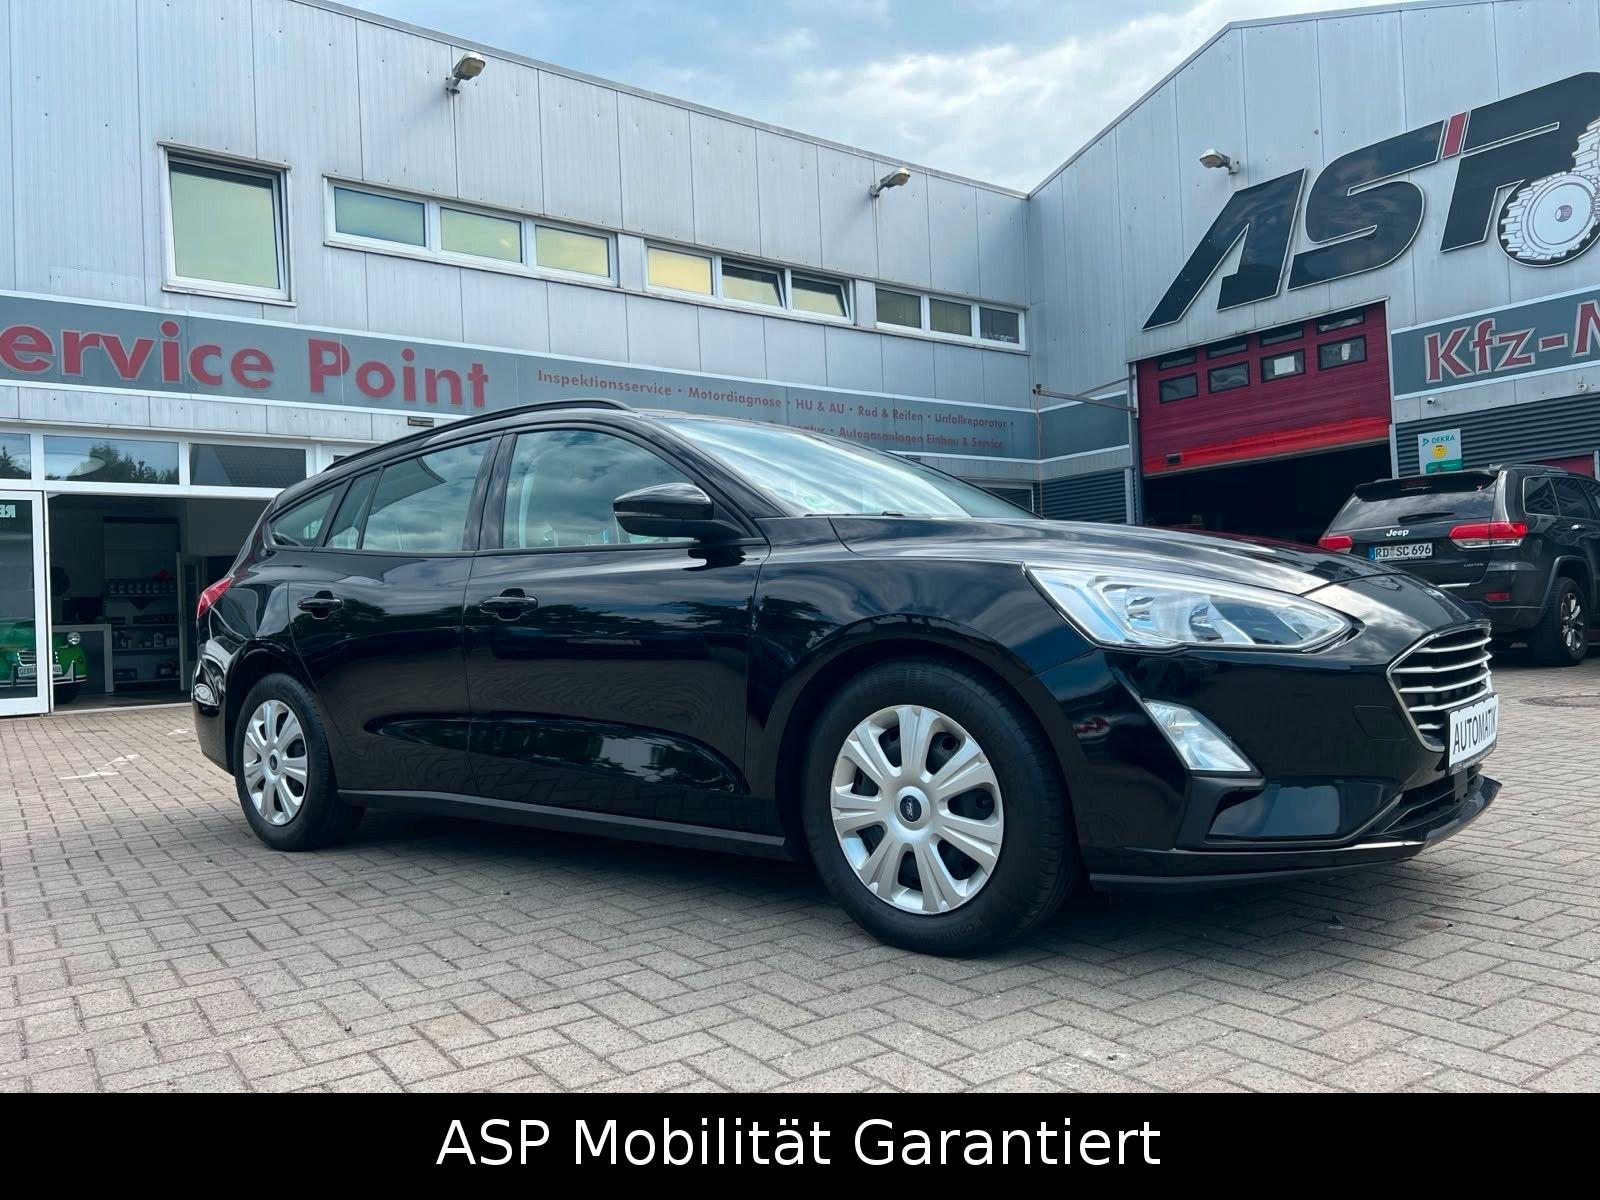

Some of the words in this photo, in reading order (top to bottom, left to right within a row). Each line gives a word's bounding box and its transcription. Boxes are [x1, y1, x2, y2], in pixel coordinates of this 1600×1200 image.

[308, 338, 489, 408] Point
[538, 369, 672, 396] Inspektionsservice
[688, 386, 782, 408] Motordiagnose
[796, 398, 813, 411] HU
[817, 400, 826, 412] &
[829, 402, 845, 414] AU
[858, 405, 878, 418] Rad
[881, 407, 889, 418] &
[893, 407, 924, 421] Reifen
[935, 412, 1008, 428] Unfallreparatur
[839, 426, 924, 446] Autogasanlagen
[926, 433, 959, 447] Einbau
[972, 436, 1004, 449] Service
[1431, 434, 1456, 444] DEKRA
[1386, 529, 1410, 537] Jeep
[1376, 547, 1389, 558] RD
[1396, 546, 1409, 556] SC
[1411, 544, 1431, 556] 696
